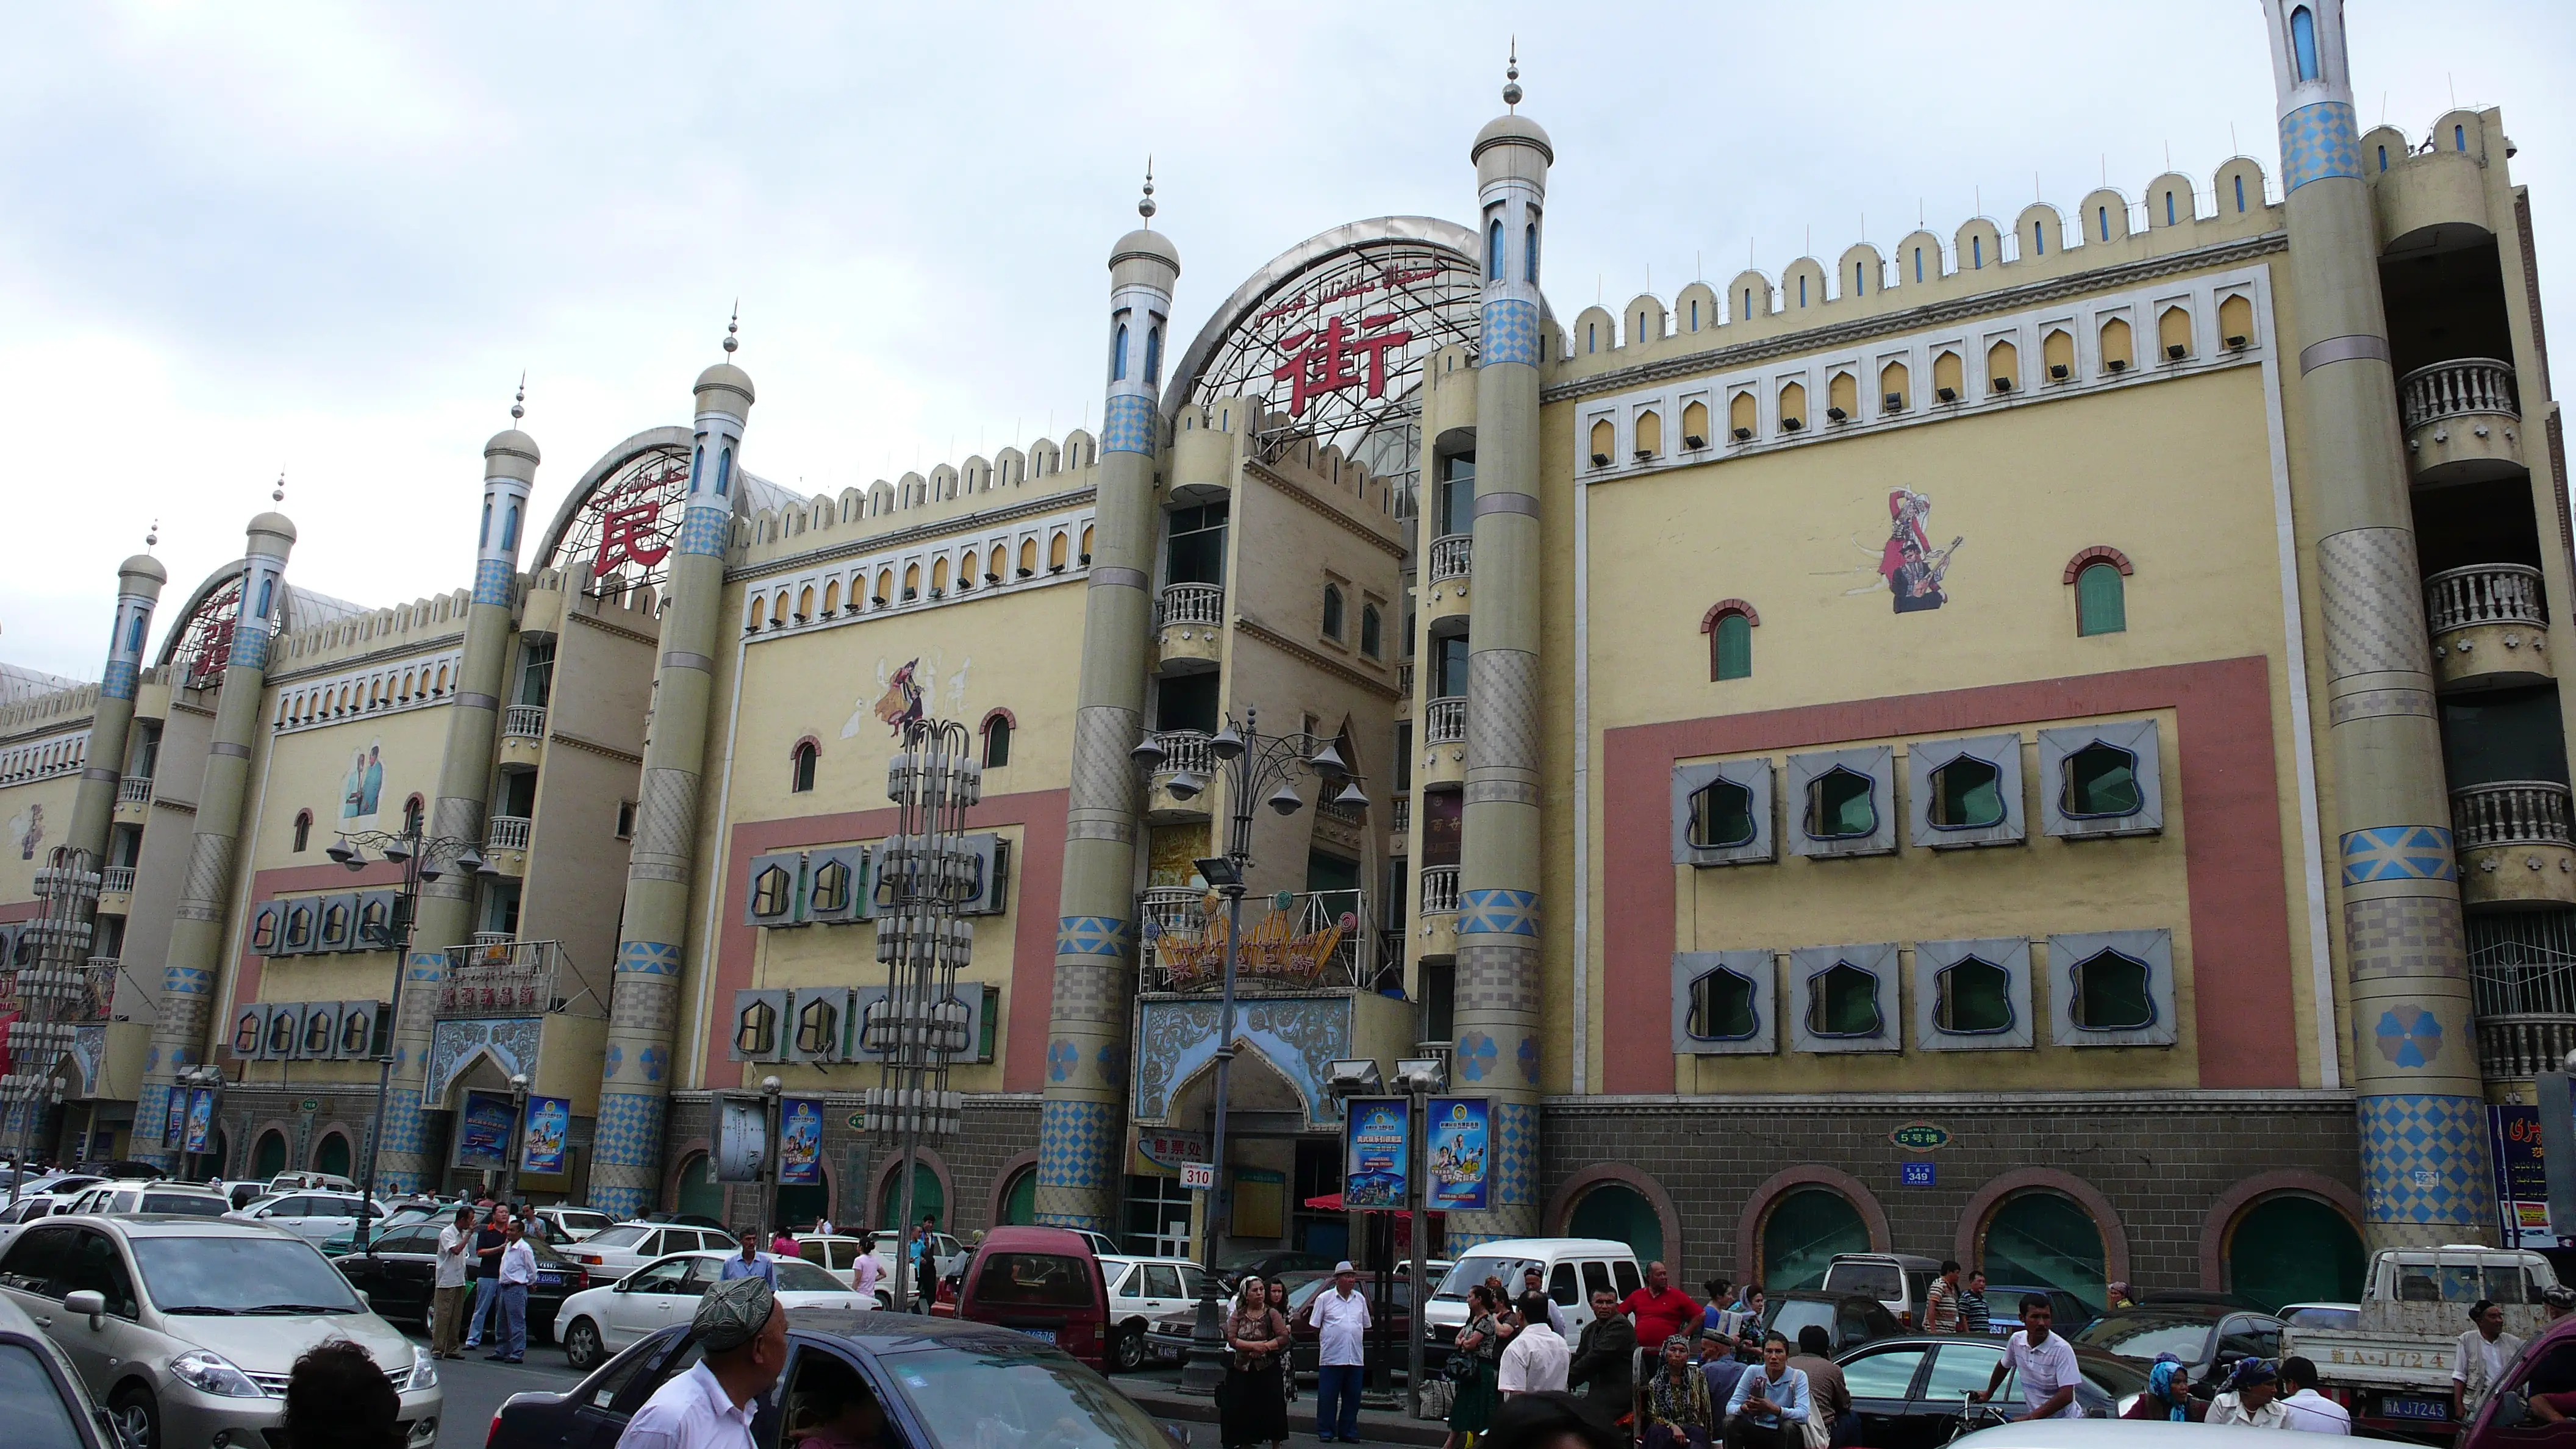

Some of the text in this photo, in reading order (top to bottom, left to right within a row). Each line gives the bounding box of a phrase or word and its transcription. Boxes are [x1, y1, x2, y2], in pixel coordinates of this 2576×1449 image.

[1273, 313, 1412, 417] 街
[594, 499, 672, 577] 民
[1901, 1133, 1937, 1143] 5号楼
[1154, 1138, 1201, 1156] 售票处
[1187, 1170, 1209, 1184] 310
[2404, 1402, 2445, 1417] J7243
